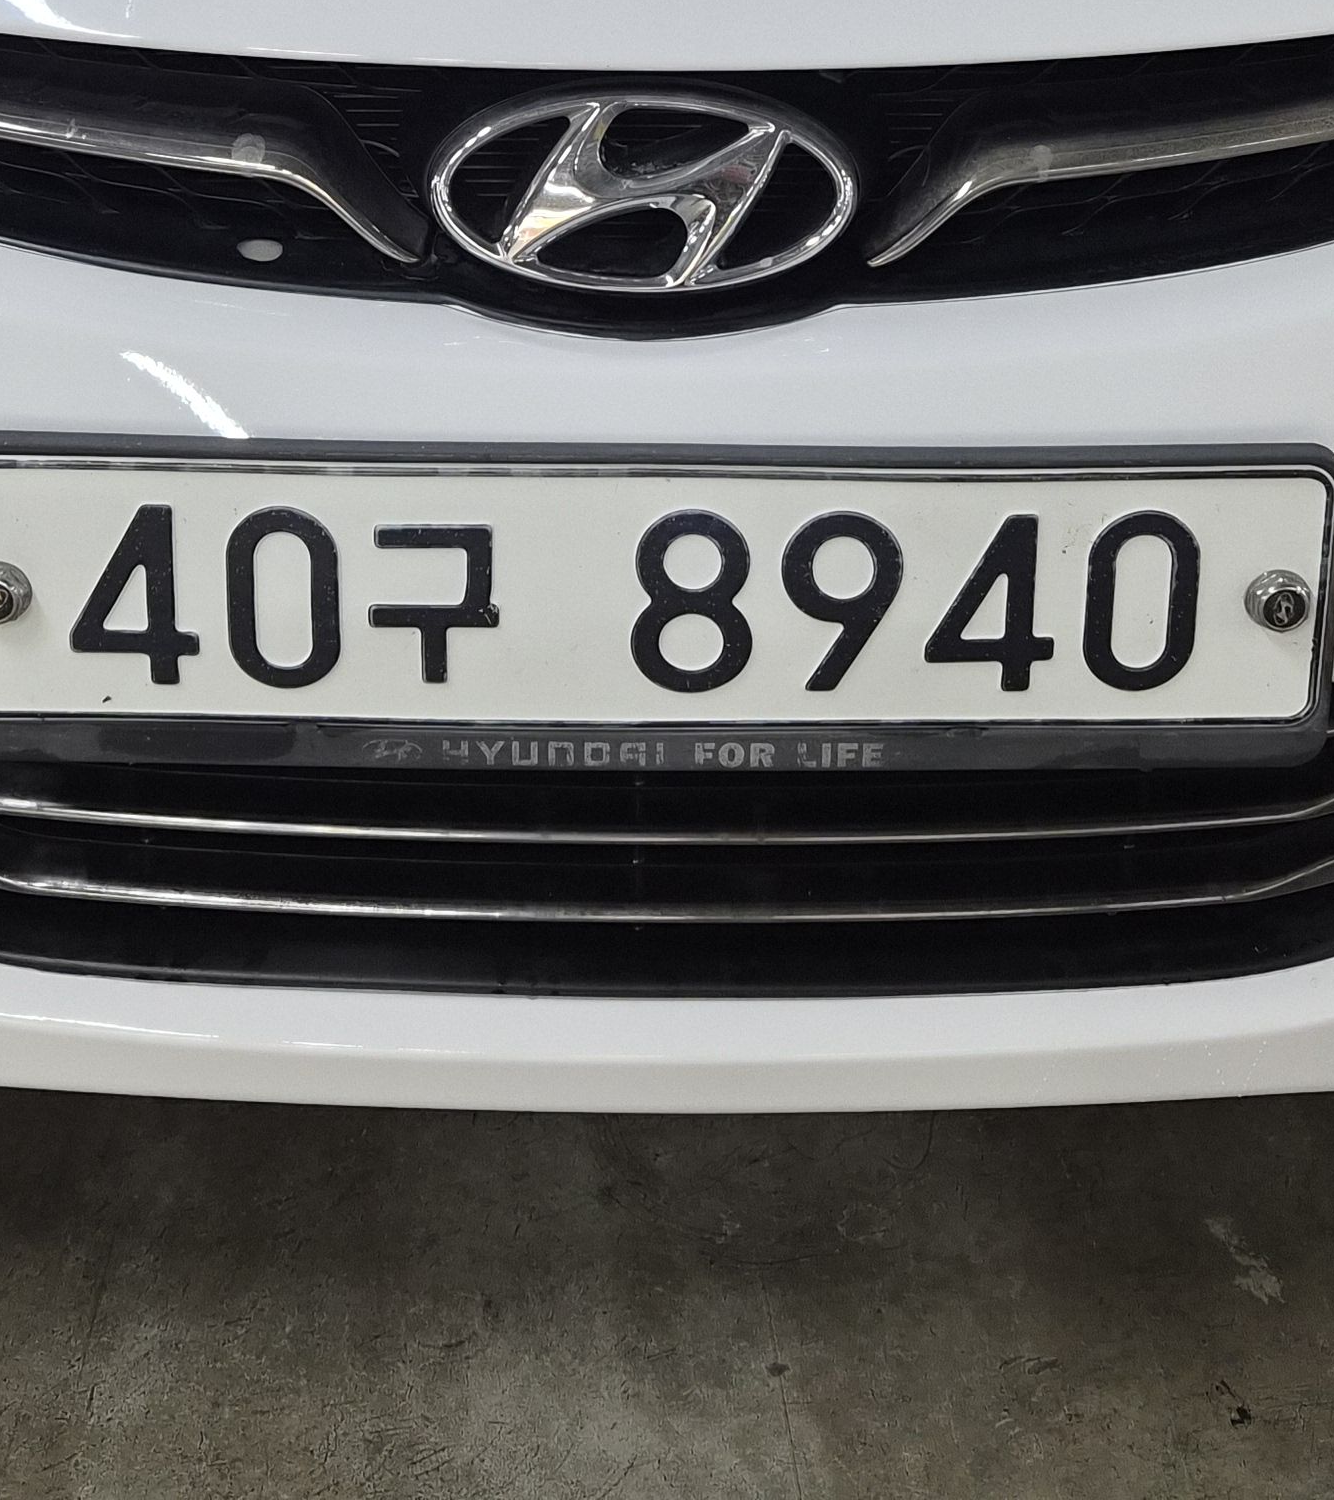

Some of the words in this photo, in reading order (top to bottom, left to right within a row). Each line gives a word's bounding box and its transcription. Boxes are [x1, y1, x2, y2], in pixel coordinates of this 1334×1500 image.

[69, 503, 501, 689] 40구
[630, 508, 1199, 693] 8940
[441, 739, 665, 767] HYUNDAI
[694, 741, 775, 768] FOR
[797, 741, 884, 768] LIFE
